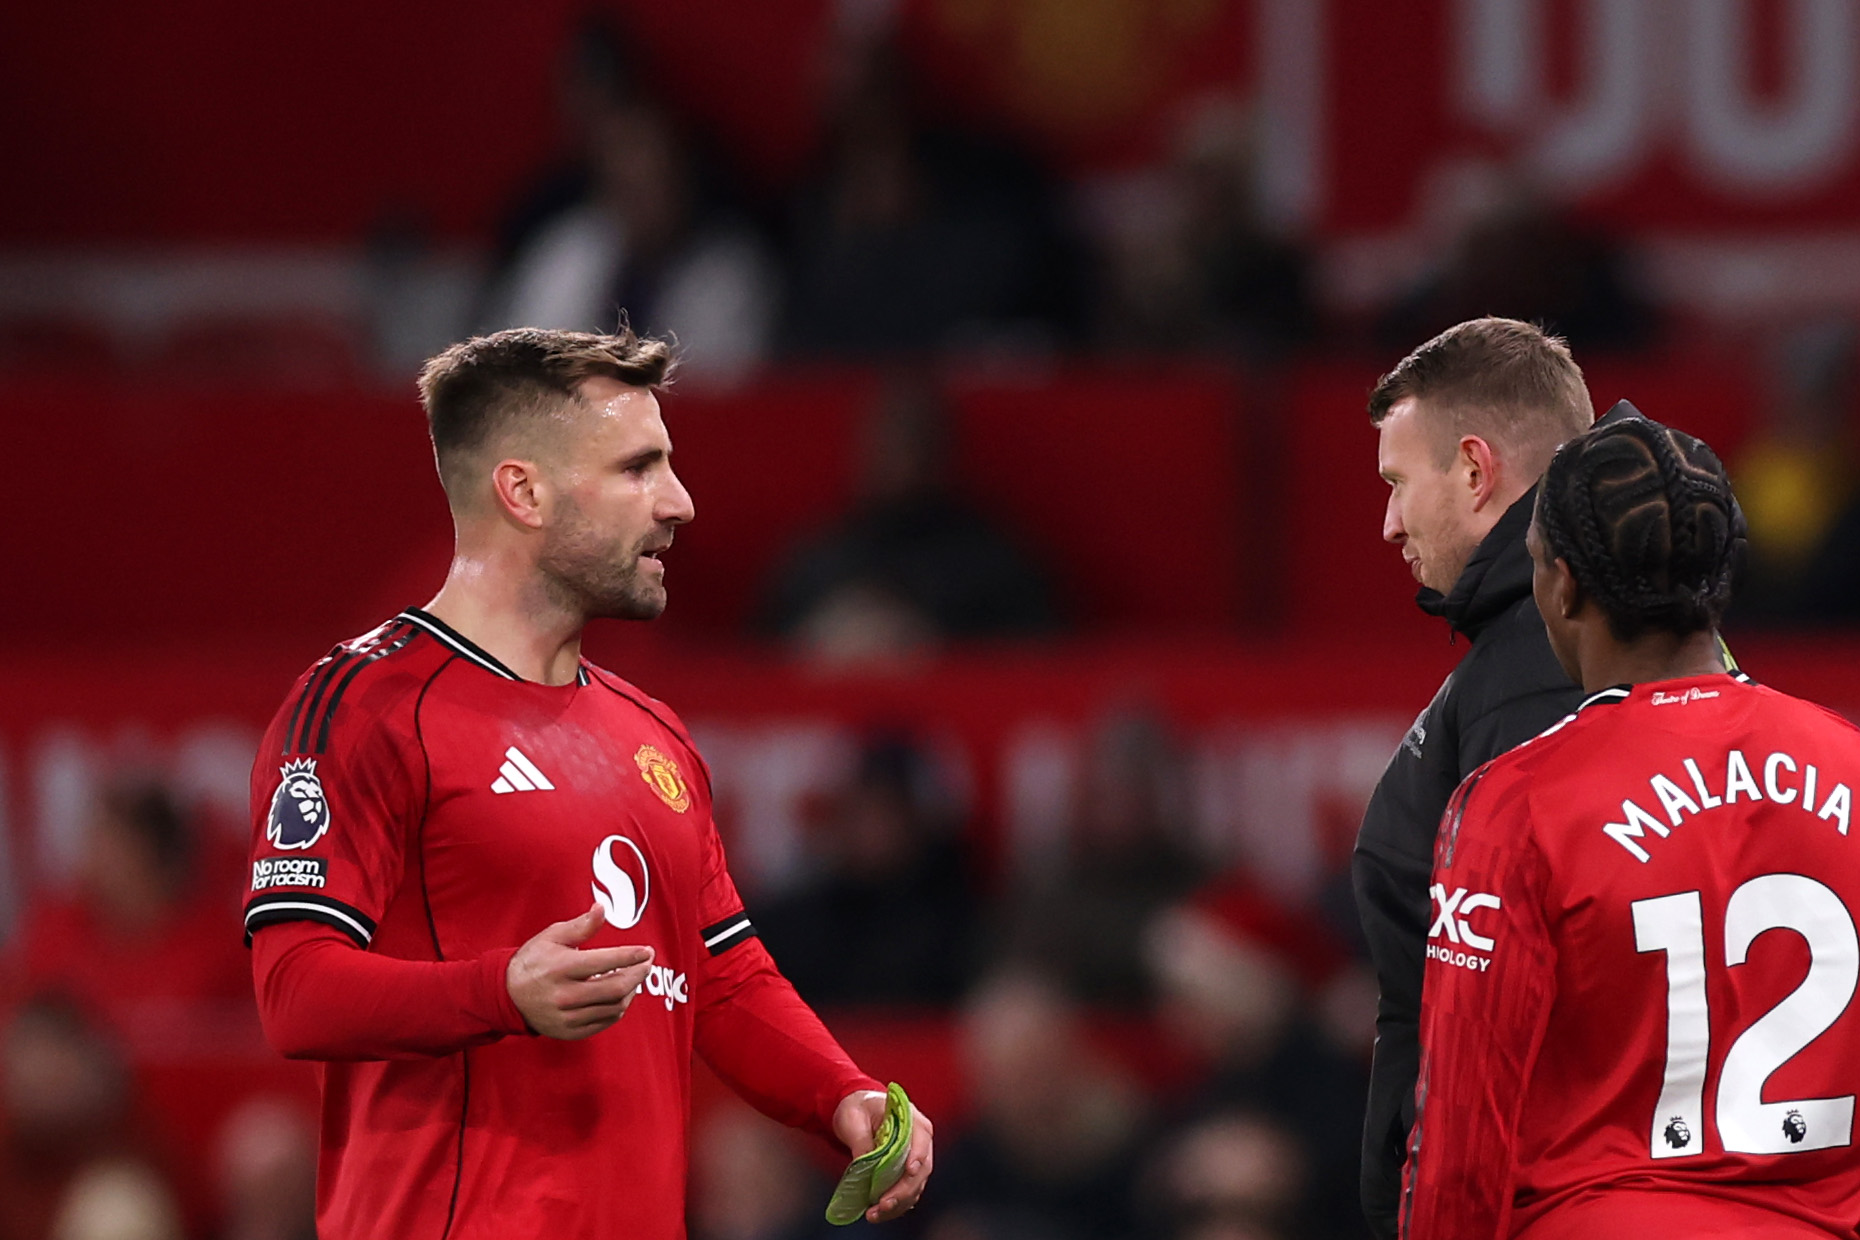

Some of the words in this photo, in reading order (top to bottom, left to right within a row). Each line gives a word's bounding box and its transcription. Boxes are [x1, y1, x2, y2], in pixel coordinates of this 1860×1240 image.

[1601, 749, 1854, 864] MALACIA
[253, 859, 273, 877] No
[273, 859, 320, 874] room
[270, 872, 325, 889] racism
[1427, 882, 1501, 952] XC
[1630, 872, 1860, 1159] 12
